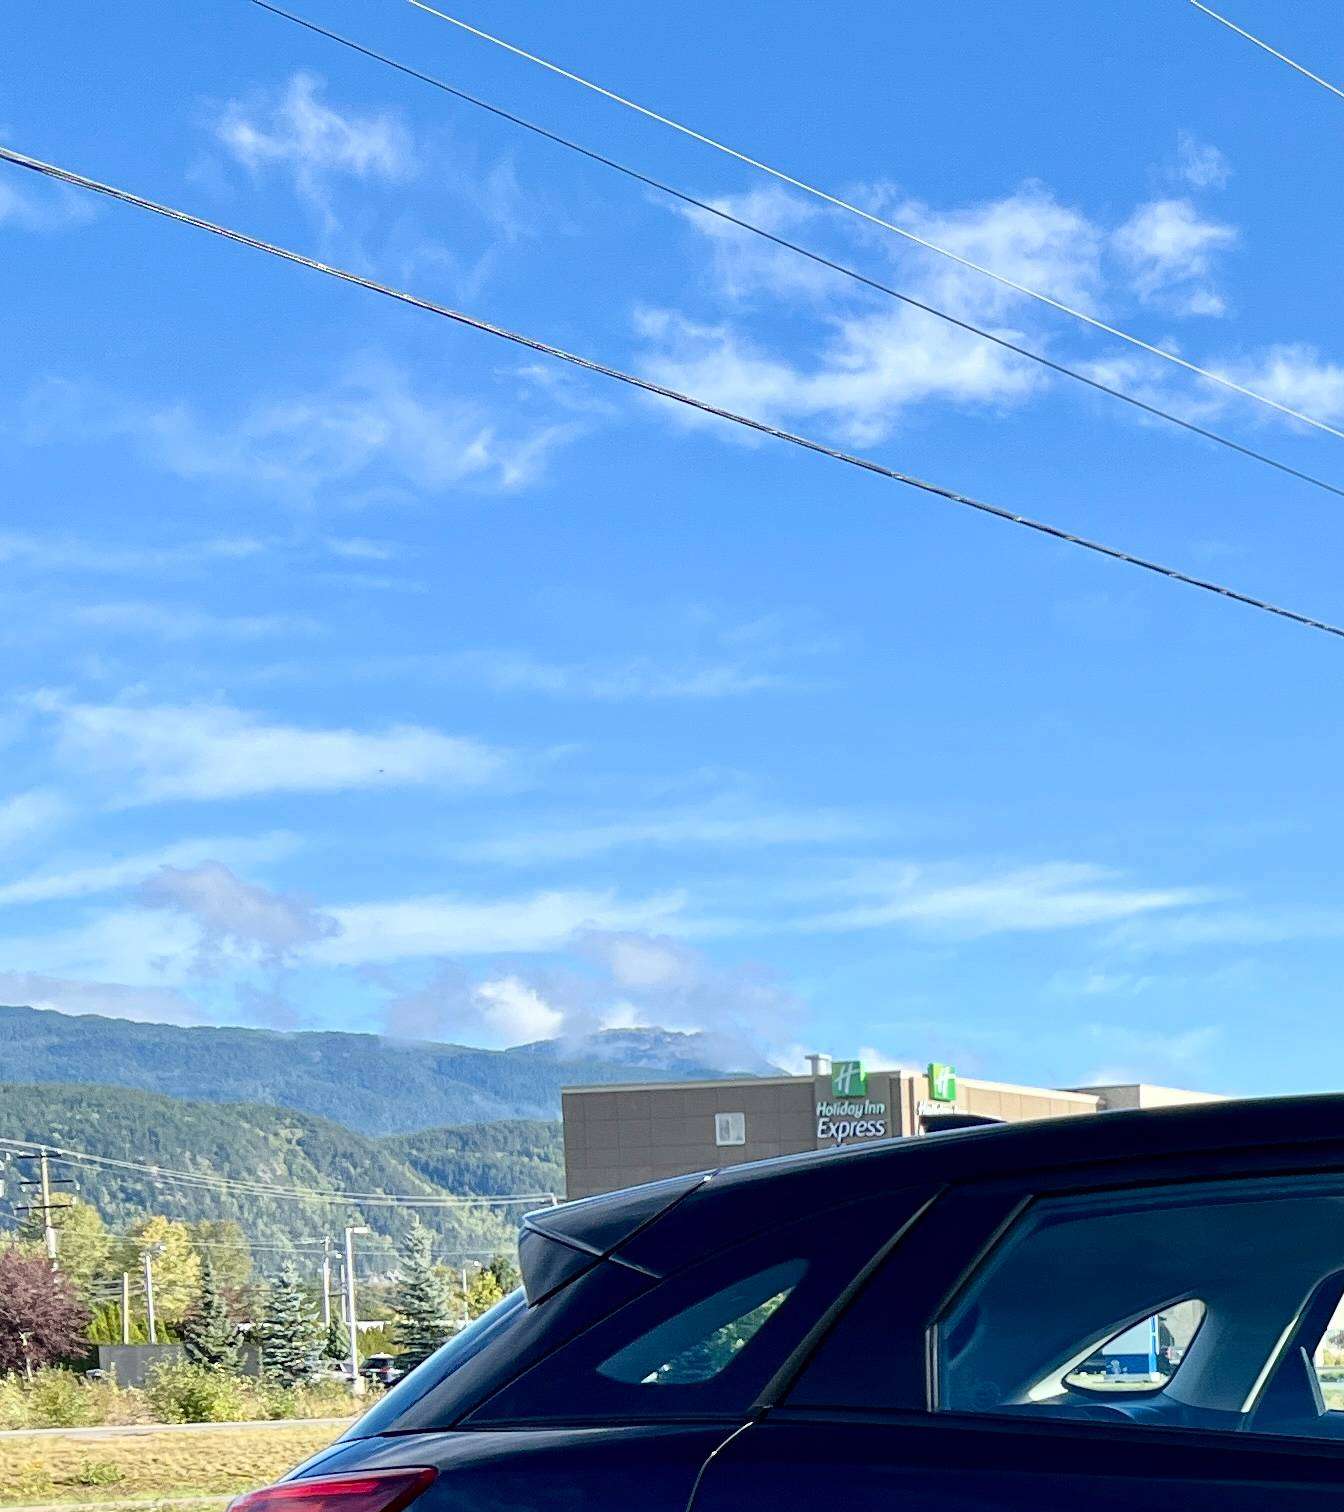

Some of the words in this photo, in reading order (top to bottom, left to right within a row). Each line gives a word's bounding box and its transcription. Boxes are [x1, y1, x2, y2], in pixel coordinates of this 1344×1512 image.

[816, 1101, 863, 1118] Holiday
[864, 1099, 885, 1114] Inn
[817, 1117, 885, 1143] Express
